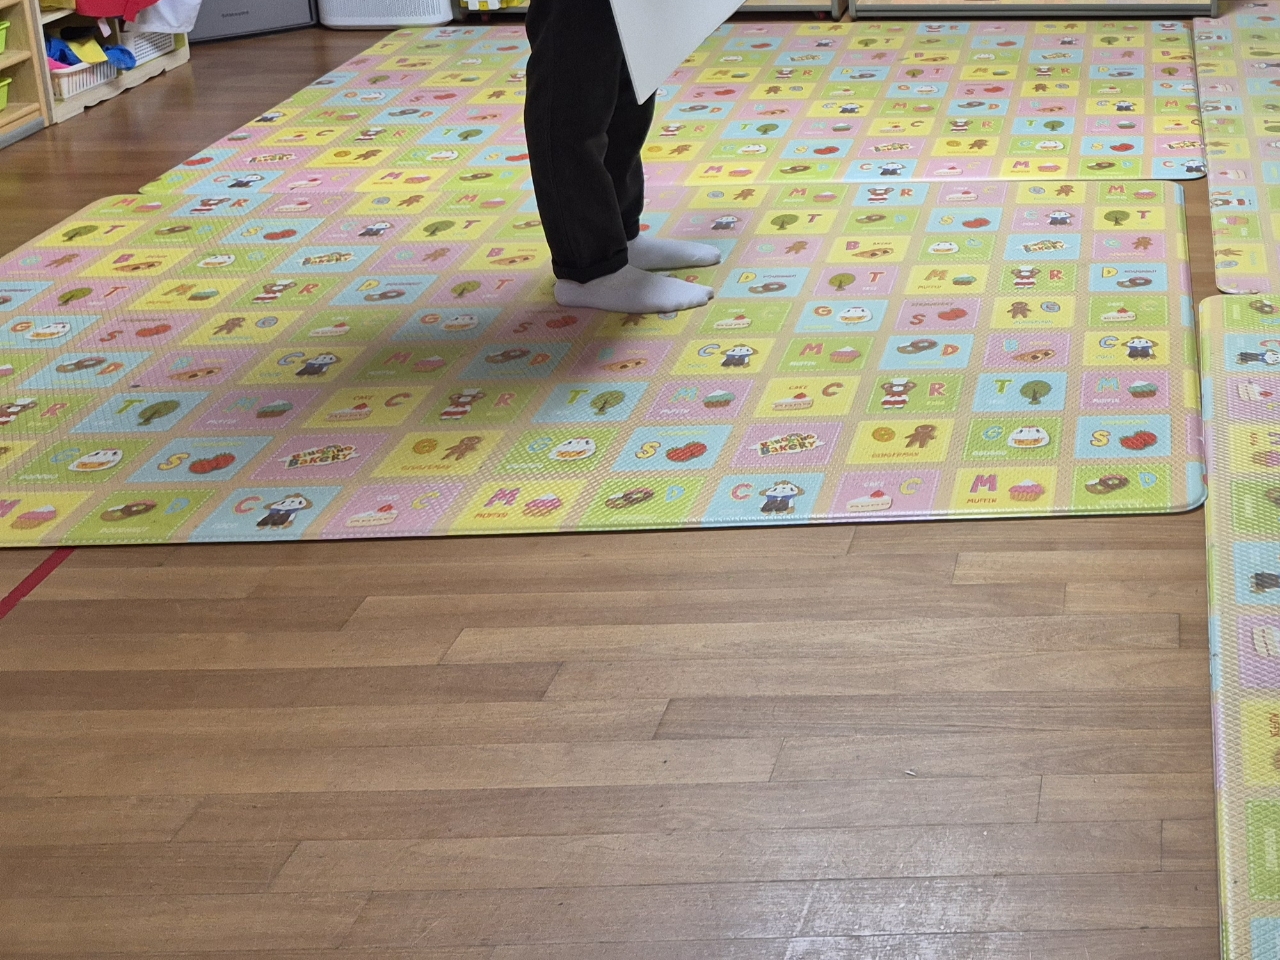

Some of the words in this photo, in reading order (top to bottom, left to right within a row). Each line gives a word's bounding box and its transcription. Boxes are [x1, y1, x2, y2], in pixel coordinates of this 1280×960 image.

[1013, 161, 1031, 169] M
[788, 187, 808, 197] M
[899, 188, 913, 197] R
[1108, 185, 1125, 193] M
[456, 194, 479, 203] M
[807, 214, 822, 223] T
[1136, 210, 1150, 219] T
[104, 225, 125, 234] T
[462, 220, 481, 229] T
[737, 272, 757, 283] D
[868, 272, 885, 282] T
[924, 269, 949, 281] M
[1049, 270, 1063, 280] R
[1101, 267, 1118, 278] D
[298, 283, 319, 294] R
[495, 279, 514, 290] T
[104, 286, 129, 298] T
[813, 306, 832, 316] G
[910, 314, 926, 326] S
[512, 322, 533, 334] S
[99, 330, 123, 342] S
[1099, 336, 1119, 349] C
[698, 344, 720, 357] C
[799, 343, 824, 357] M
[941, 343, 959, 357] D
[277, 351, 305, 366] C
[384, 351, 414, 365] M
[529, 353, 551, 366] D
[822, 382, 844, 397] C
[928, 382, 947, 397] R
[993, 379, 1012, 394] T
[1097, 378, 1119, 392] M
[384, 392, 412, 407] C
[494, 392, 517, 407] R
[566, 389, 588, 404] T
[670, 387, 699, 402] M
[40, 403, 68, 418] R
[115, 399, 145, 414] T
[982, 425, 1004, 440] G
[1090, 430, 1111, 447] S
[528, 437, 553, 453] G
[635, 441, 661, 459] S
[157, 453, 191, 470] S
[899, 478, 922, 495] C
[970, 474, 998, 493] M
[1137, 472, 1157, 487] D
[483, 487, 521, 507] M
[665, 485, 685, 502] D
[730, 483, 753, 500] C
[164, 497, 190, 515] D
[233, 496, 262, 514] C
[411, 491, 440, 510] C
